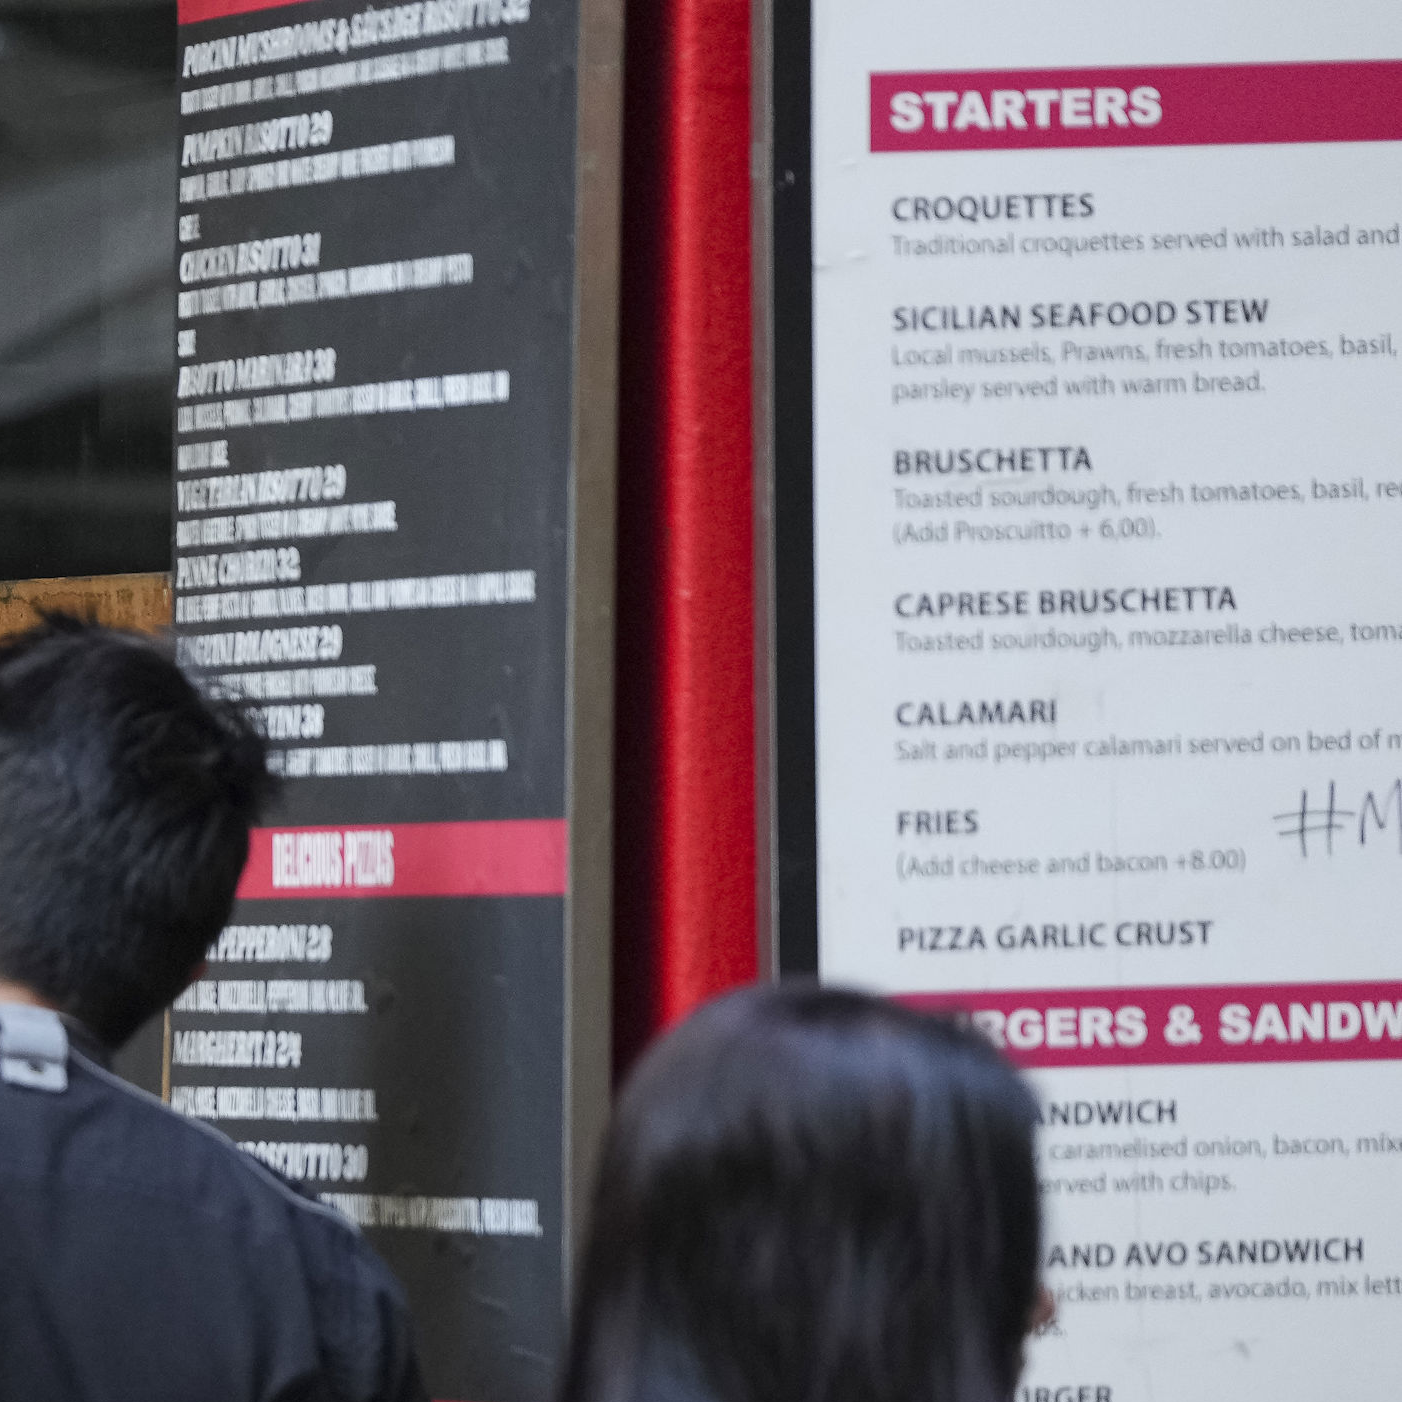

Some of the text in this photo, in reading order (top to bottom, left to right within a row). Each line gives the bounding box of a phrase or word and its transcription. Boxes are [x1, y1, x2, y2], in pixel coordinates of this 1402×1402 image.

[889, 85, 1163, 134] STARTERS
[892, 193, 1095, 223] CROQUETTES
[892, 224, 1401, 260] Traditional croquettes served with salad and
[892, 298, 1269, 332] SICILIAN SEAFOOD STEW
[892, 332, 1398, 368] Local mussels, Prawns, fresh tomatoes, basil,
[892, 371, 1265, 405] parsley served with warm bread.
[893, 447, 1093, 477] BRUSCHETTA
[893, 477, 1370, 512] Toasted sourdough, fresh tomatoes, basil,
[893, 521, 948, 546] (Add
[894, 585, 1238, 619] CAPRESE BRUSCHETTA
[894, 631, 984, 653] Toasted
[991, 628, 1124, 654] sourdough,
[1128, 624, 1253, 648] mozzarella
[1258, 622, 1345, 647] cheese,
[895, 698, 1058, 728] CALAMARI
[895, 728, 1383, 765] Salt and pepper calamari served on bed of
[896, 809, 980, 838] FRIES
[897, 851, 953, 879] (Add
[959, 853, 1040, 876] cheese
[1047, 851, 1091, 875] and
[1097, 848, 1168, 873] bacon
[898, 919, 1214, 952] PIZZA GARLIC CRUST
[965, 1004, 1148, 1050] RGERS
[1164, 1004, 1204, 1045] &
[1049, 1132, 1349, 1161] caramelised onion, bacon,
[1041, 1171, 1237, 1195] erved with chips.
[1045, 1237, 1365, 1268] AND AVO SANDWICH
[1125, 1279, 1203, 1302] breast,
[1209, 1279, 1310, 1301] avocado,
[1317, 1276, 1357, 1298] mix
